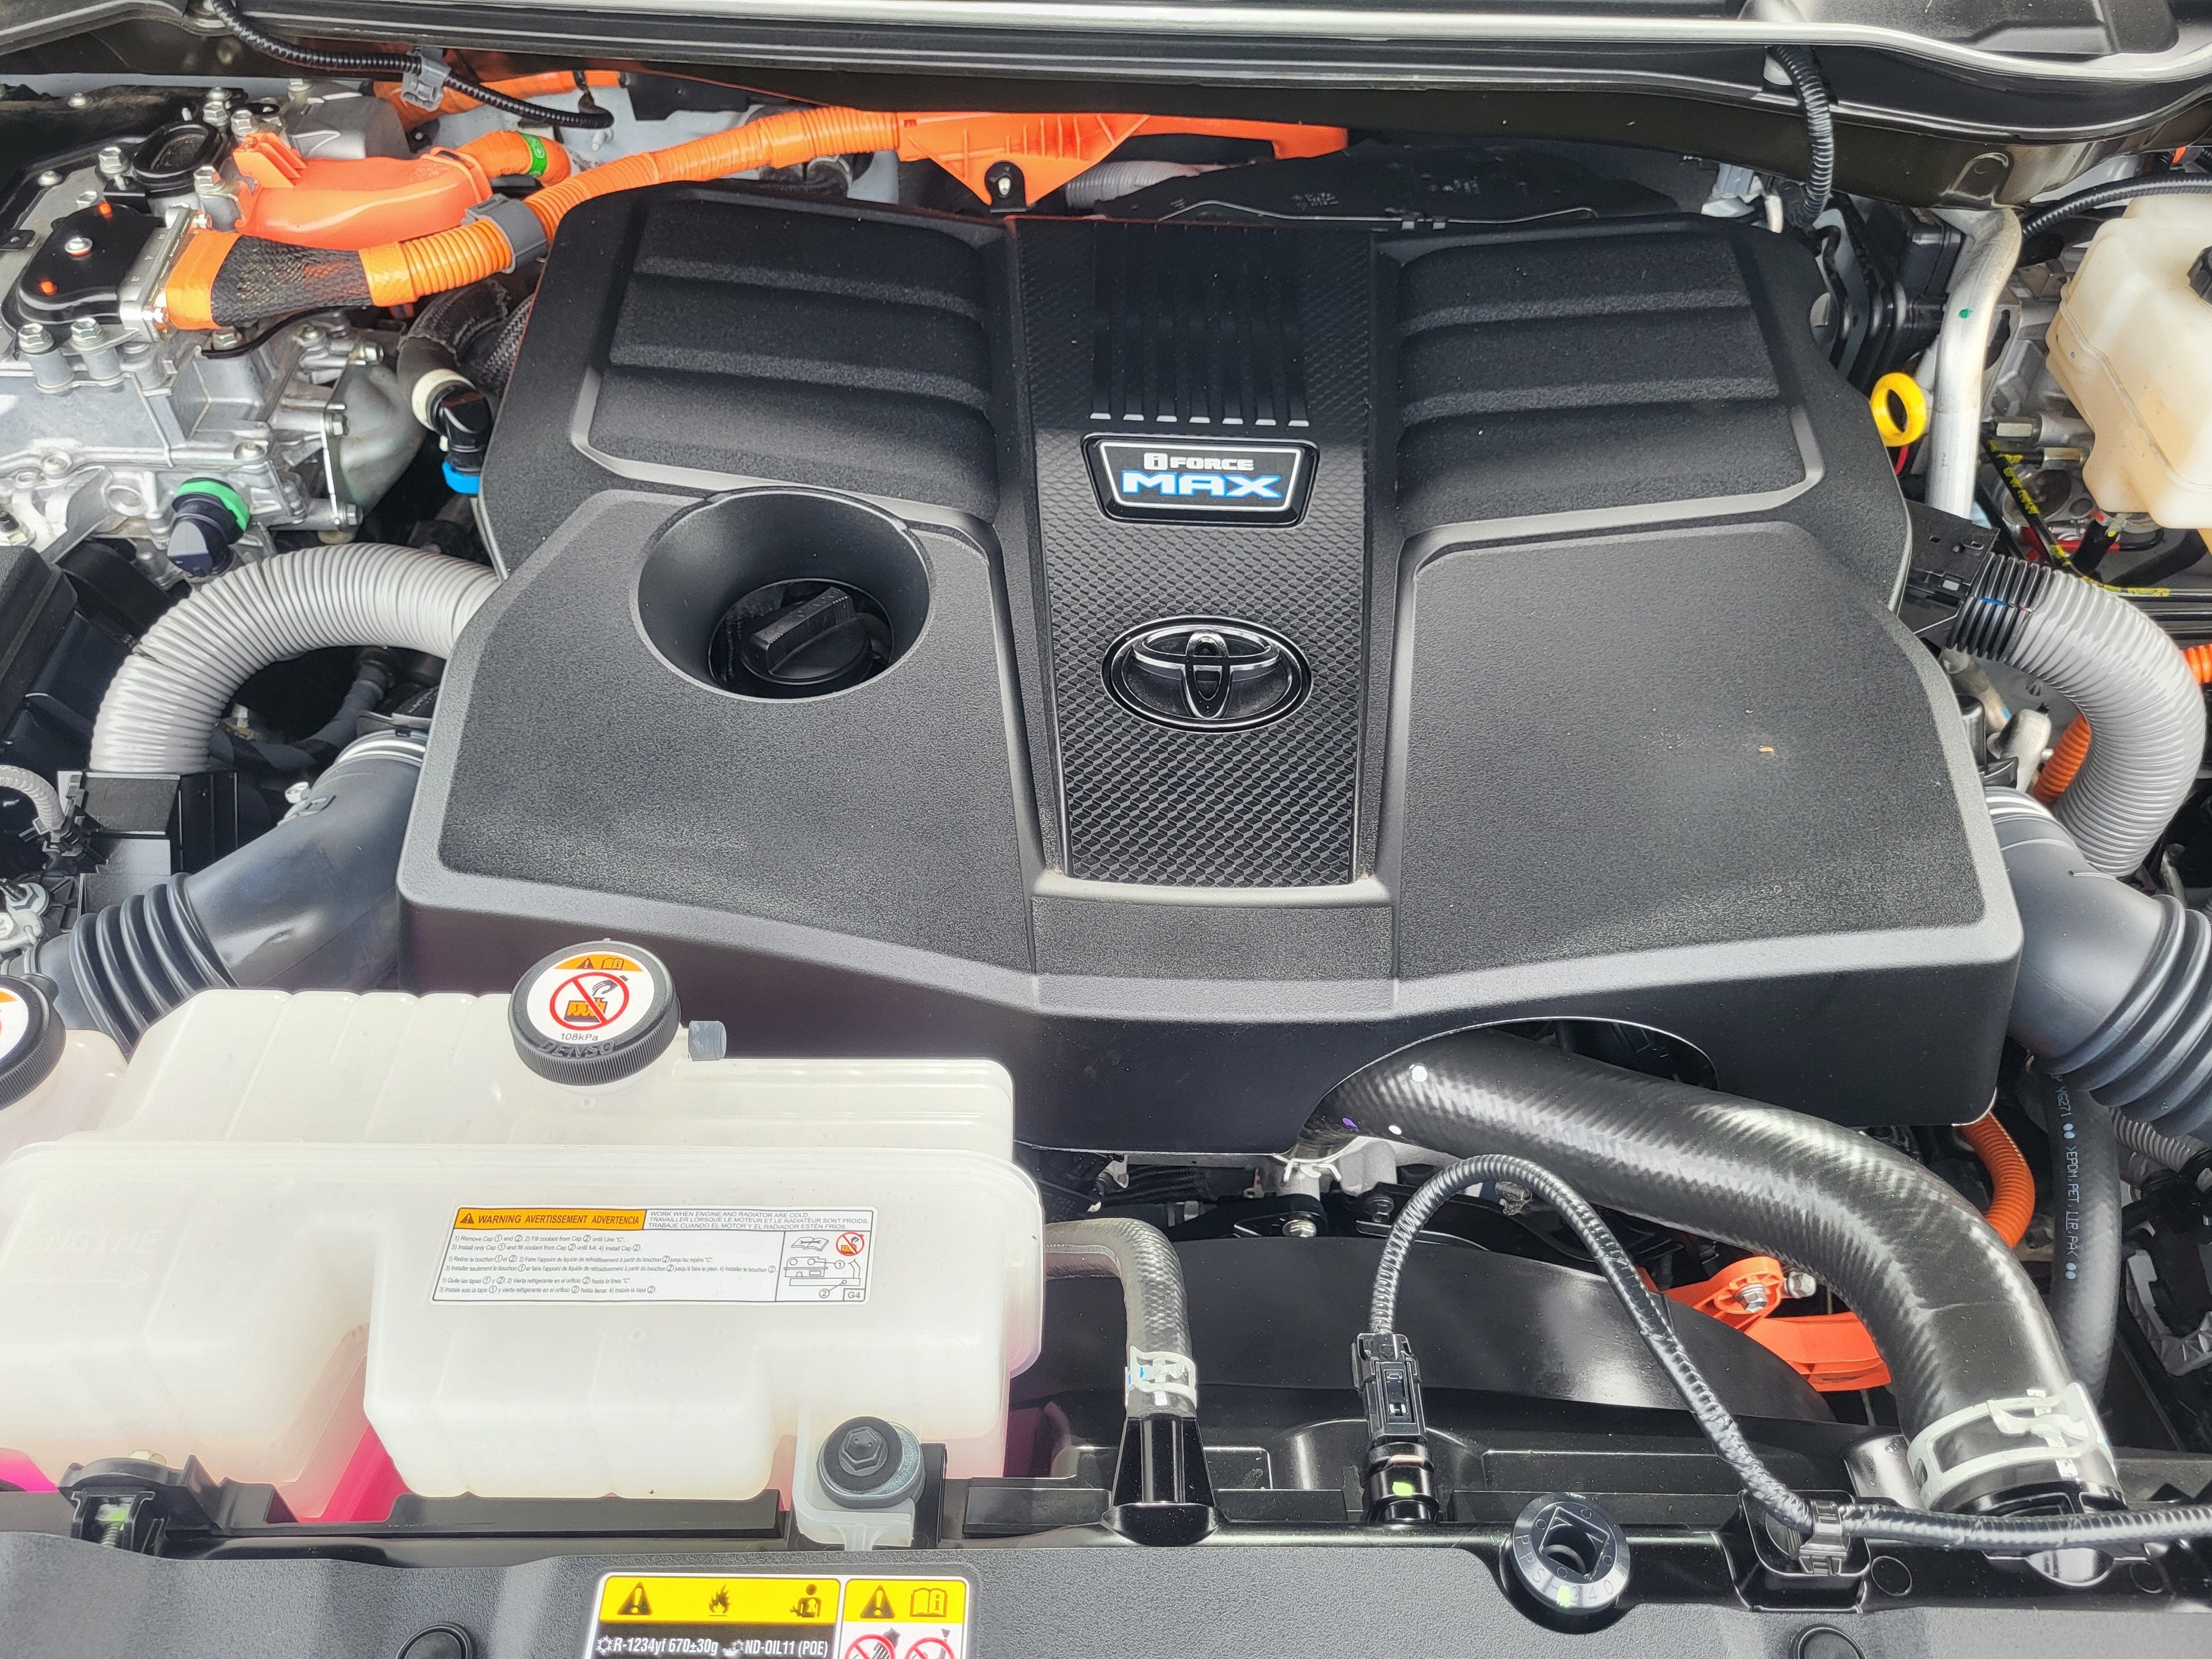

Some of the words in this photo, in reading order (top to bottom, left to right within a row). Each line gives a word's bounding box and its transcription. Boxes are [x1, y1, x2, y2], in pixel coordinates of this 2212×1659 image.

[1170, 456, 1254, 471] FORCE
[1121, 470, 1282, 498] MAX
[560, 1032, 598, 1041] 108kPa
[538, 1040, 614, 1058] DENSO
[478, 1214, 521, 1224] WARNING
[524, 1215, 590, 1224] AVERTISSEMENT
[591, 1215, 639, 1224] ADVERTENCIA
[613, 1637, 666, 1656] R-1234yf
[668, 1637, 719, 1656] 670±30g
[798, 1640, 828, 1658] (POE)
